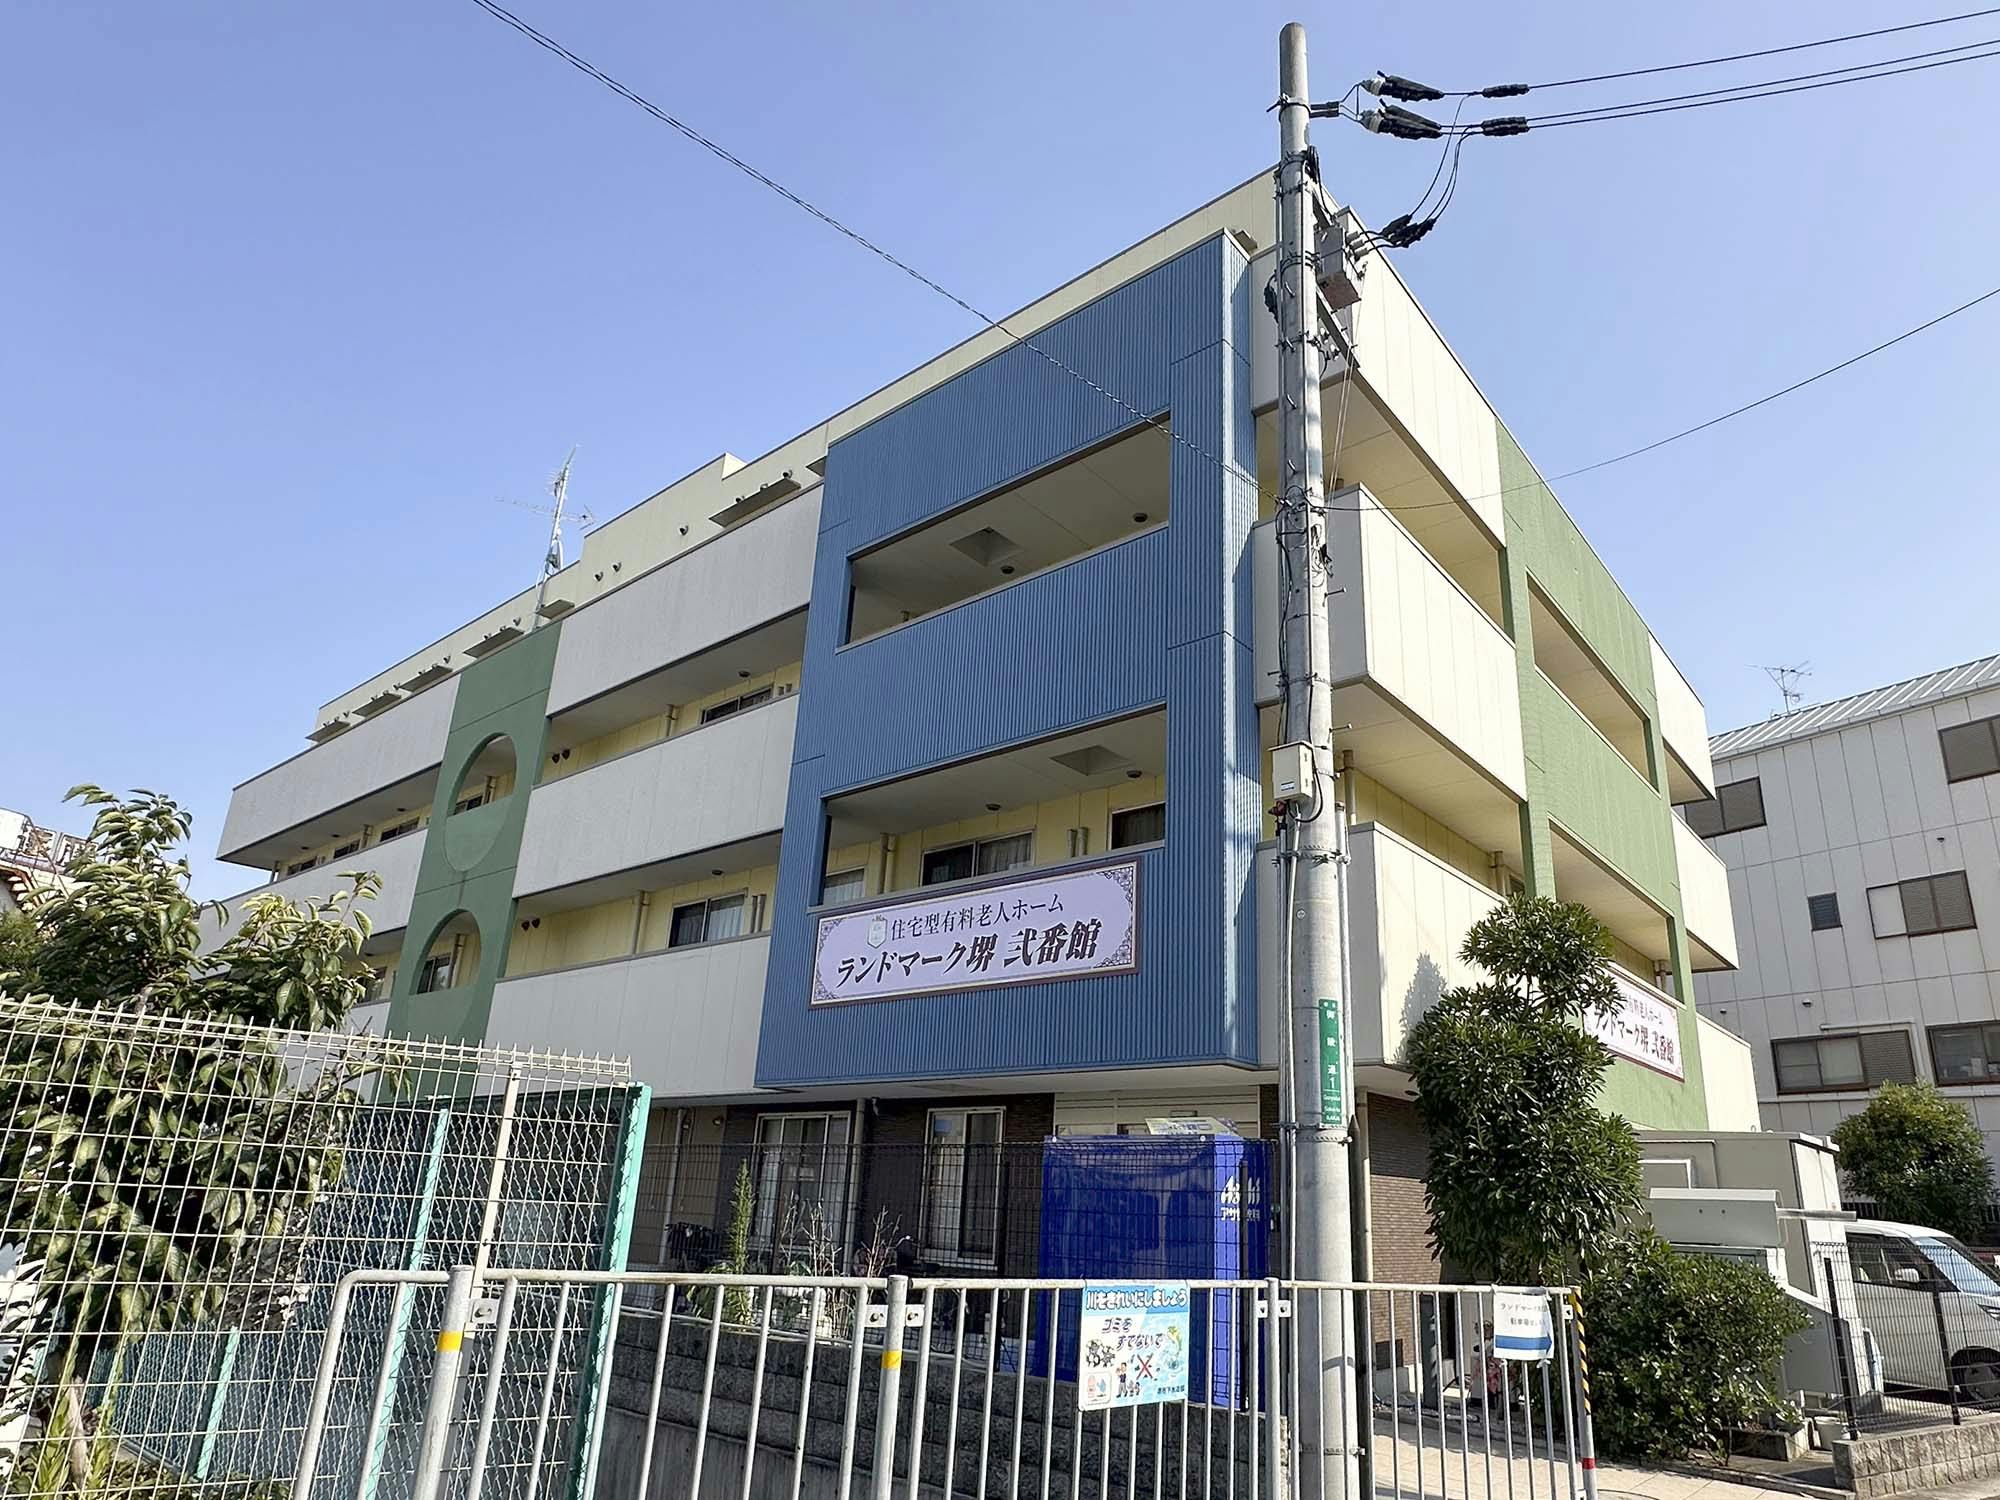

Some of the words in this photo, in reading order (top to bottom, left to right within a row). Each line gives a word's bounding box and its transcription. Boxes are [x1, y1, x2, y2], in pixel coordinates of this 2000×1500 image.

[890, 894, 1064, 941] 住宅型有料老人ホーム
[836, 933, 998, 988] ランドマーク堺
[1002, 917, 1102, 969] 弐番館
[1220, 1175, 1261, 1205] Ashi
[1086, 1288, 1188, 1311] 川をきれいにしましょう
